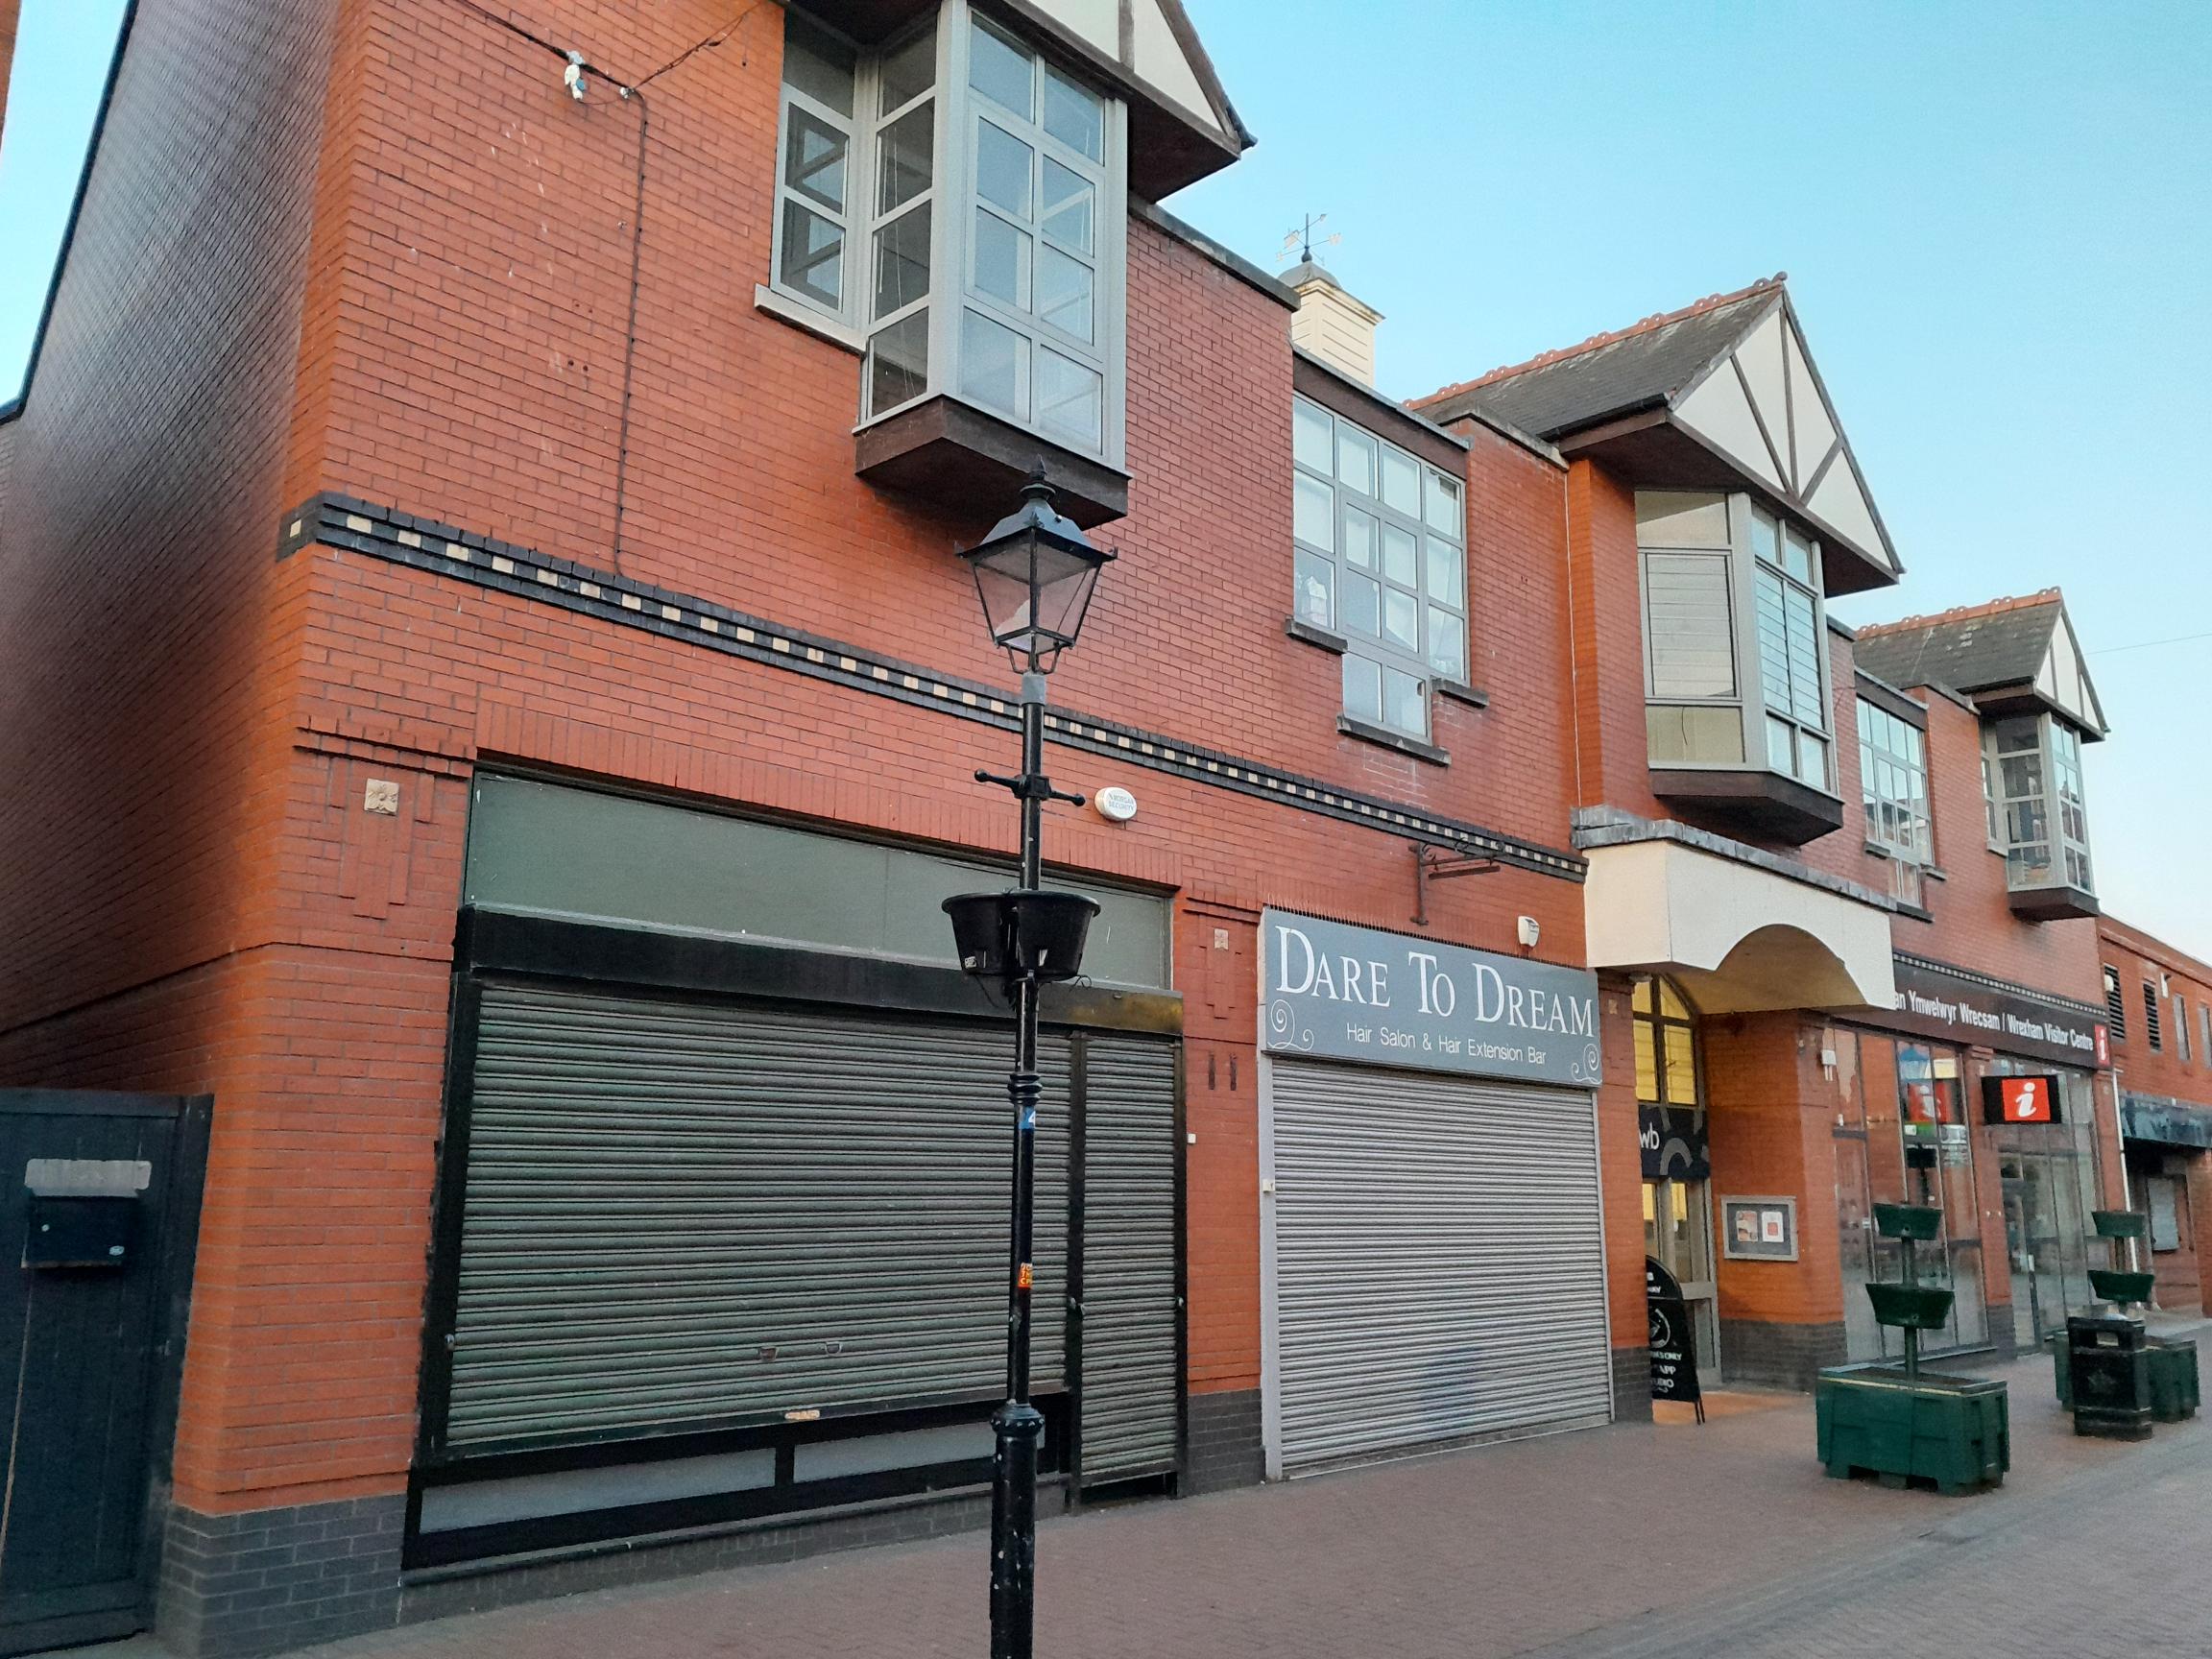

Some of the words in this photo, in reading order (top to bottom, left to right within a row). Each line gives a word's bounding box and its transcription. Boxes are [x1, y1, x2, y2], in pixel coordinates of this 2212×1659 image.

[1275, 926, 1391, 1007] DARE
[1472, 963, 1594, 1037] DREAM
[1346, 1022, 1372, 1043] Hair
[1380, 1026, 1416, 1048] Salon
[1422, 1033, 1432, 1051] &
[1438, 1034, 1462, 1053] Hair
[1468, 1038, 1524, 1062] Extension
[1527, 1046, 1547, 1064] Bar
[1960, 1002, 2001, 1031] Wrecsam
[2007, 1013, 2044, 1040] Wrexham
[2044, 1022, 2069, 1046] Visitor
[2070, 1028, 2094, 1051] Centre
